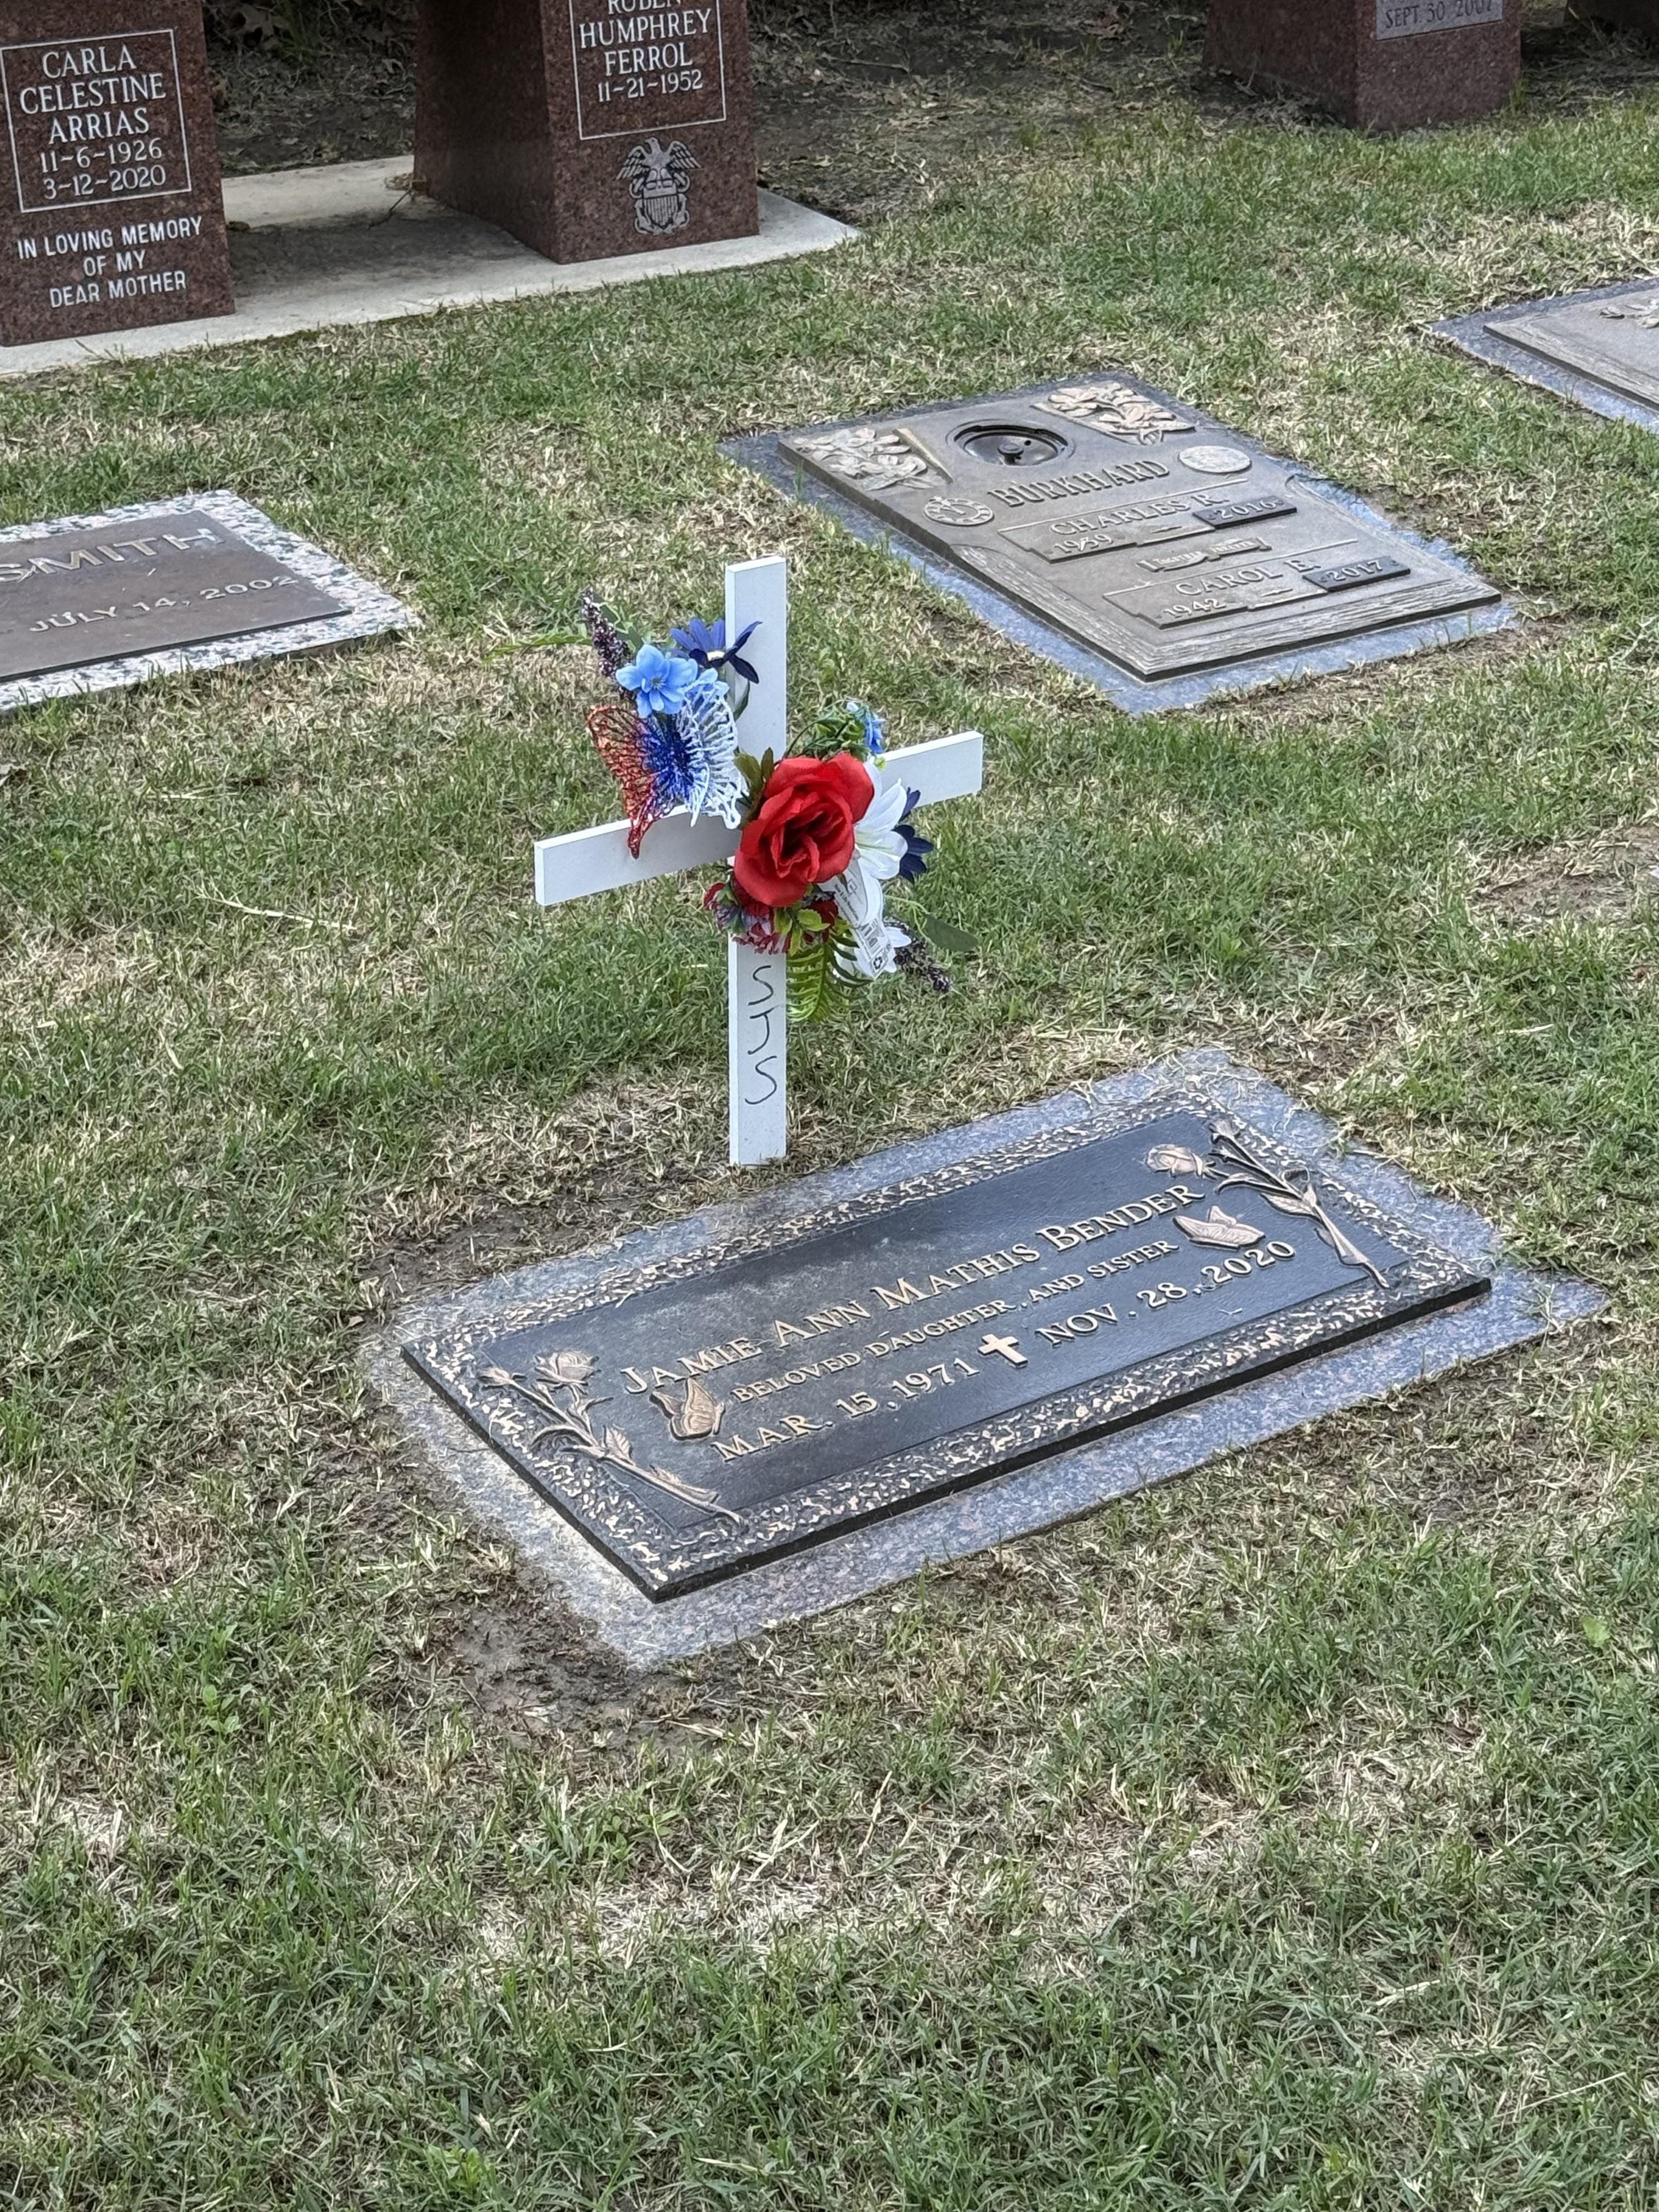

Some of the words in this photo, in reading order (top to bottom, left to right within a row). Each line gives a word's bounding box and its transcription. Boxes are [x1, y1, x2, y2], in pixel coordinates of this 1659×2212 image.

[579, 8, 711, 48] HUMPHREY
[42, 44, 137, 78] CARLA
[604, 42, 693, 76] FERROL
[20, 72, 166, 115] CELESTINE
[598, 70, 703, 102] 11-21-1952
[48, 107, 149, 145] ARRIAS
[41, 138, 162, 173] 11-6-1926
[44, 165, 166, 200] 3-12-2020
[17, 239, 37, 259] IN
[44, 229, 113, 257] LOVING
[121, 216, 202, 246] MEMORY
[83, 255, 106, 277] OF
[116, 250, 146, 272] MY
[49, 284, 99, 308] DEAR
[109, 271, 187, 299] MOTHER
[987, 460, 1170, 507] BURKHARD
[1050, 499, 1191, 535] CHARLES
[1192, 492, 1230, 510] R.
[1214, 500, 1277, 520] 2016
[0, 528, 223, 583] SMITH
[1163, 597, 1227, 618] 1942
[1326, 559, 1384, 582] 2017
[1175, 567, 1283, 596] CAROL
[1284, 558, 1321, 573] E.
[29, 606, 117, 633] JULY
[620, 1337, 764, 1393] JAMIE
[774, 1300, 871, 1347] ANN
[870, 1243, 1041, 1311] MATHIS
[1036, 1185, 1205, 1252] BENDER
[730, 1352, 861, 1403] BELOVED
[1028, 1274, 1084, 1303] AND
[1087, 1240, 1180, 1278] SISTER
[711, 1414, 833, 1462] MAR.
[892, 1358, 980, 1400] 1971
[1035, 1302, 1136, 1346] NOV.
[1201, 1242, 1295, 1284] 2020
